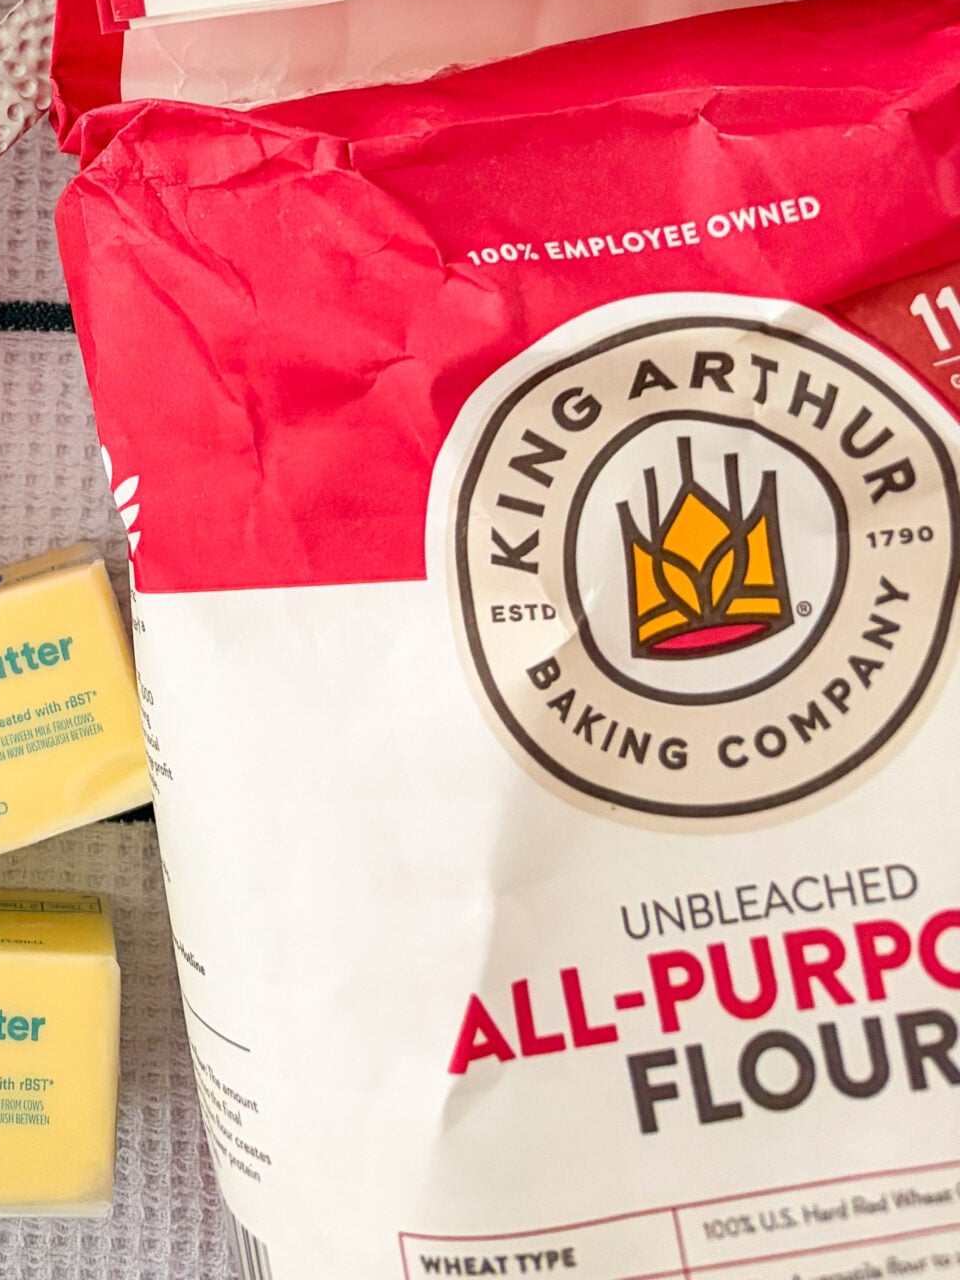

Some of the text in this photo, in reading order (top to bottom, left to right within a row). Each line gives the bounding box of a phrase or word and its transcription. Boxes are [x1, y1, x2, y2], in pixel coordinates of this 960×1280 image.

[467, 196, 821, 266] 100% EMPLOYEE OWNED
[491, 350, 917, 574] KING ARTHUR
[866, 526, 934, 549] 1790
[491, 604, 557, 623] ESTD
[525, 574, 910, 771] BAKING COMPANY
[35, 701, 61, 719] with
[620, 864, 919, 940] UNBLEACHED
[627, 1008, 960, 1134] FLOUR
[704, 1198, 887, 1240] 100% U.S. Hard Red
[421, 1248, 577, 1277] WHEAT TYPE
